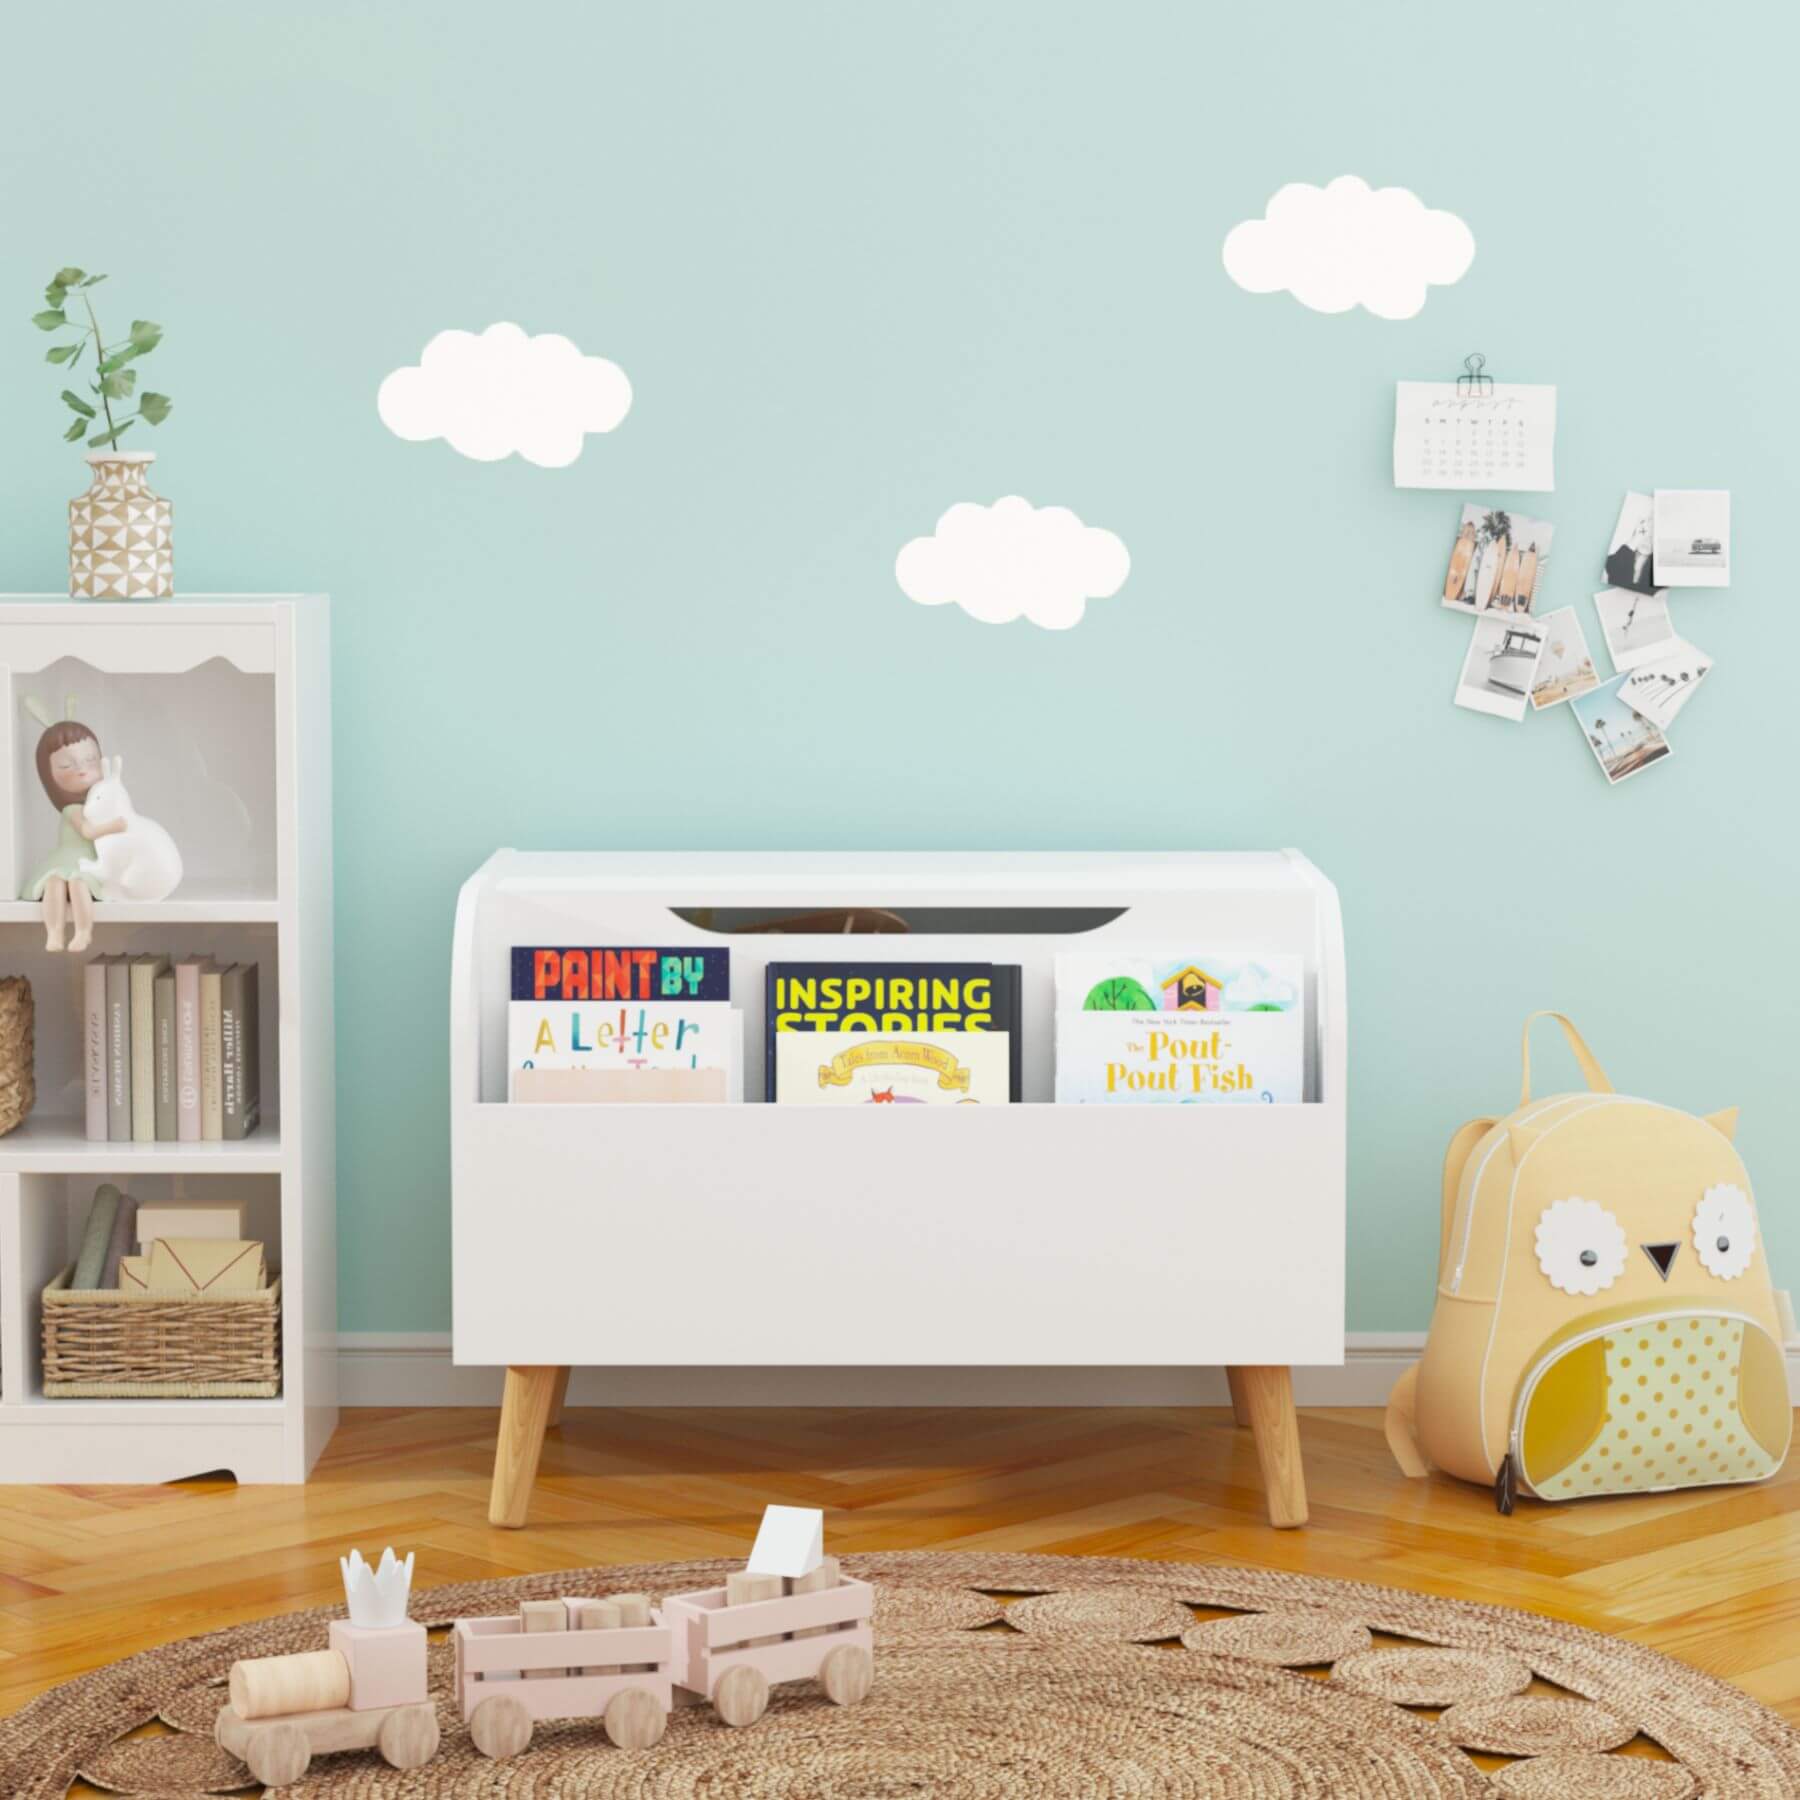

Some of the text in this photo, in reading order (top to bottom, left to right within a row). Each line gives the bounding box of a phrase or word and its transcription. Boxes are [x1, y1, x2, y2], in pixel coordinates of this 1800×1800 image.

[533, 950, 704, 1000] PAINT BY
[776, 977, 991, 1010] INSPIRING
[534, 1008, 700, 1054] A Letter
[1127, 1030, 1232, 1062] The Pout-
[1106, 1063, 1253, 1093] Pout Fish
